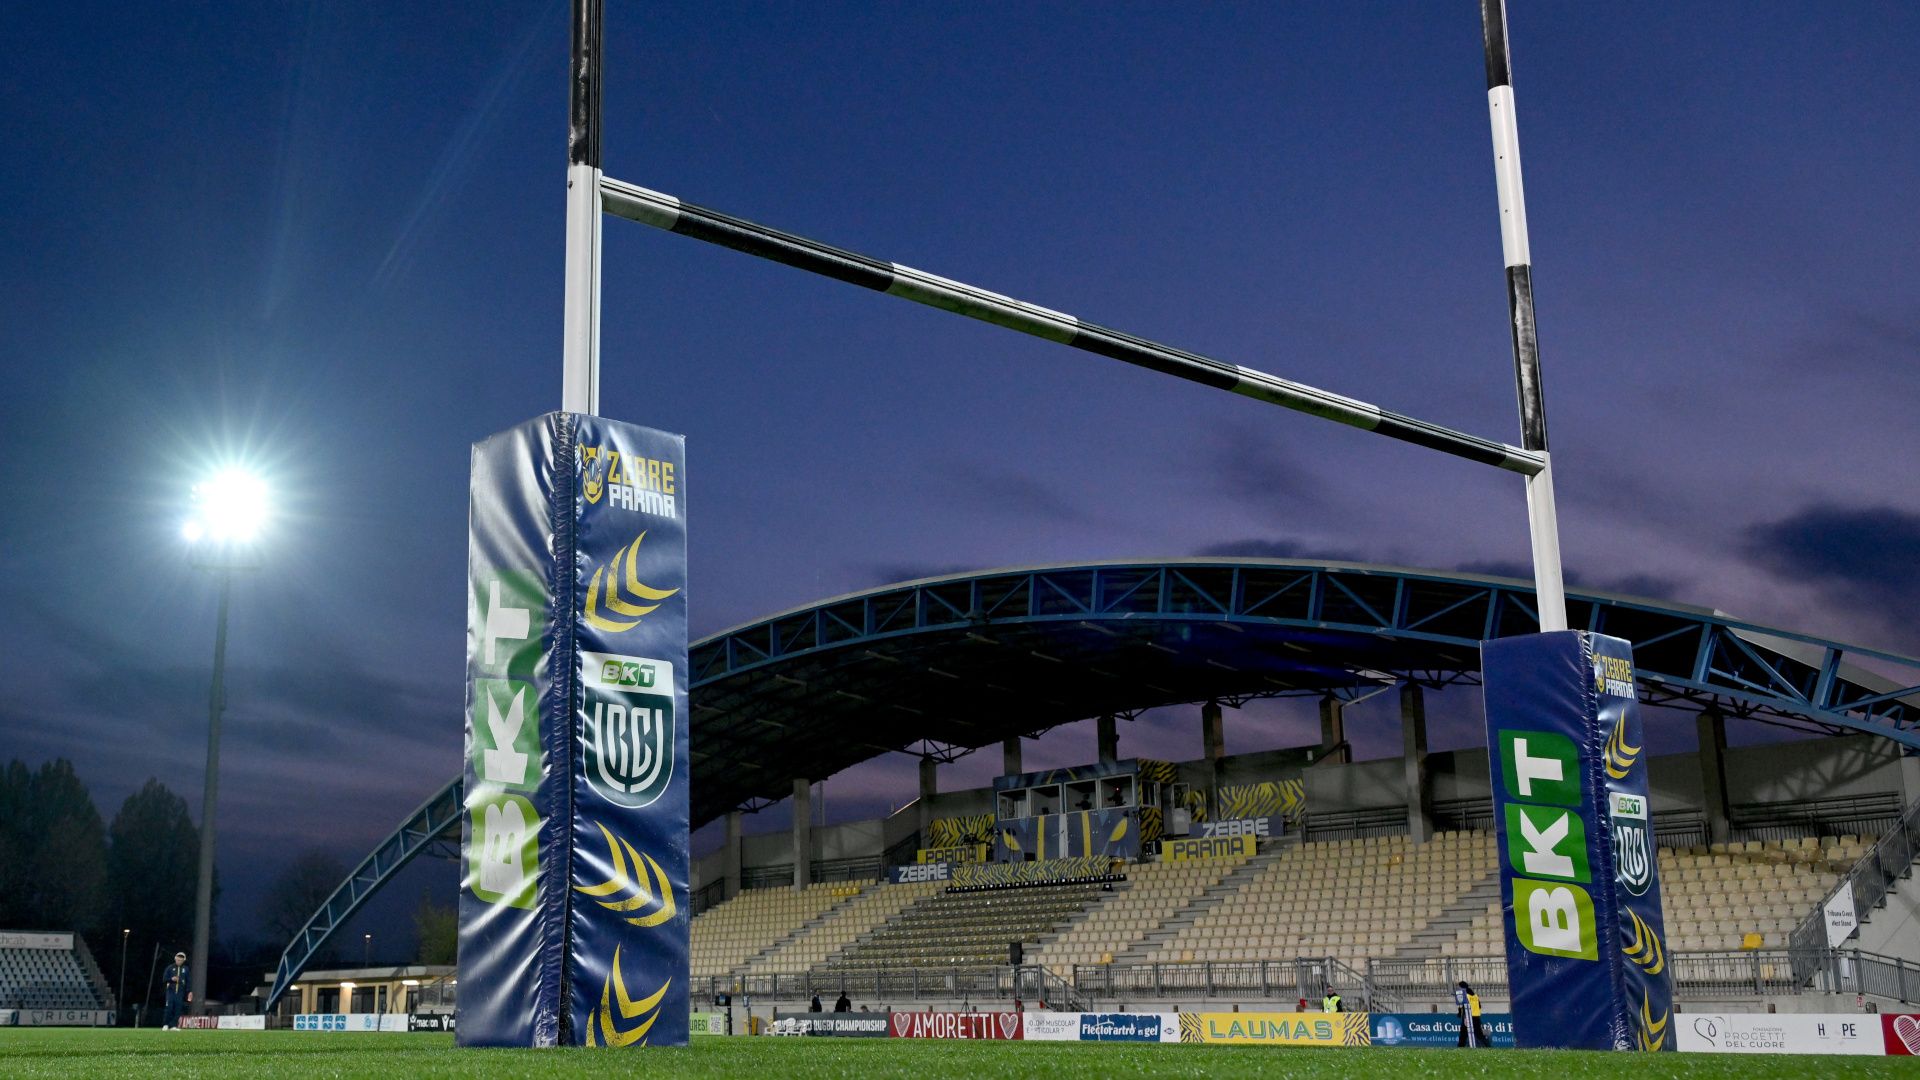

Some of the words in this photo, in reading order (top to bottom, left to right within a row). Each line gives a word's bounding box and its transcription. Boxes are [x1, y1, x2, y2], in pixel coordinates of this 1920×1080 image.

[608, 484, 676, 518] PARMA
[602, 662, 655, 685] BKT
[1602, 656, 1632, 682] ZEBRE
[1605, 679, 1635, 699] PARMA
[480, 580, 530, 898] BKT
[1618, 800, 1641, 815] BKT
[1202, 818, 1269, 838] ZEBRE
[1173, 837, 1244, 860] PARMA
[1514, 738, 1582, 952] BKT
[899, 863, 947, 882] ZEBRE
[45, 1011, 89, 1021] RIGH
[416, 1019, 439, 1028] macon
[690, 1019, 708, 1031] URES!
[813, 1019, 835, 1031] RUGBY
[835, 1019, 887, 1032] CHAMPIONSHIP
[913, 1013, 995, 1039] AMORETTI
[1144, 1025, 1158, 1037] gel
[1209, 1020, 1332, 1040] LAUMAS
[1409, 1022, 1431, 1032] Casa
[1433, 1022, 1443, 1032] di
[1444, 1022, 1461, 1032] Cur
[1495, 1022, 1506, 1033] di
[1724, 1032, 1786, 1041] PROGETTI
[1749, 1041, 1785, 1049] CUORE
